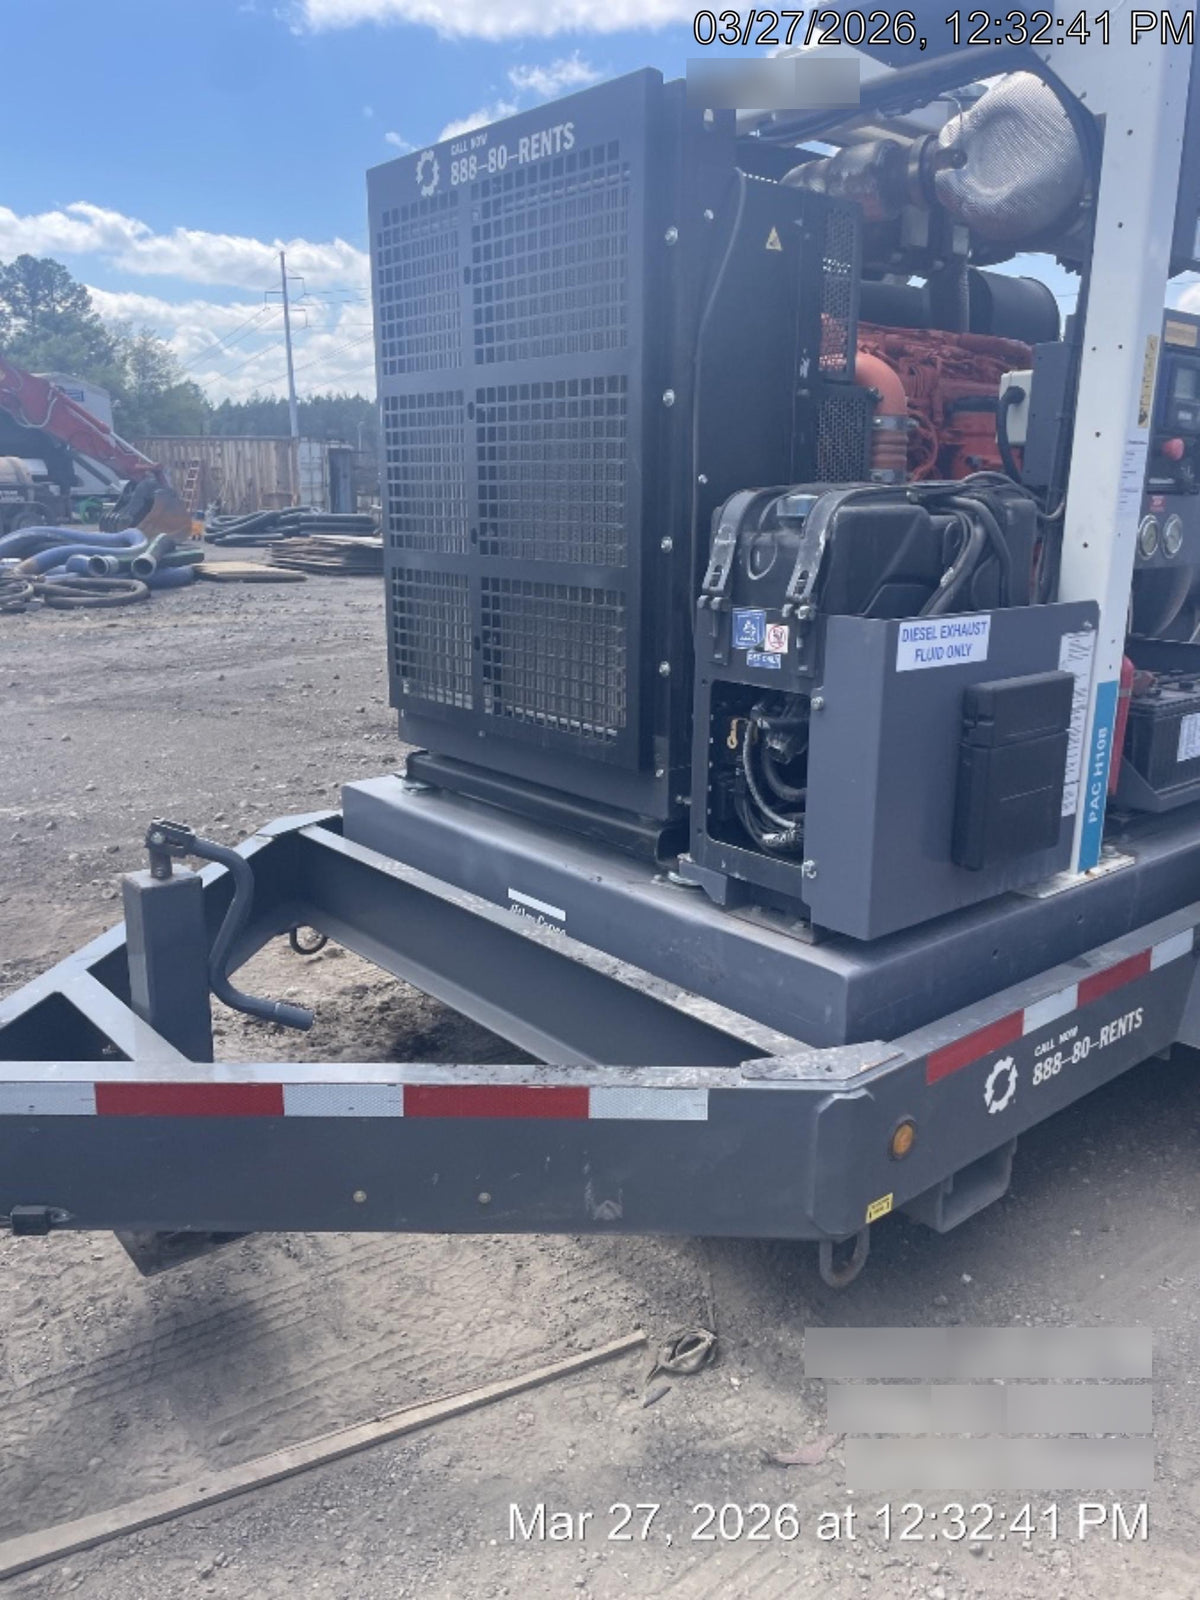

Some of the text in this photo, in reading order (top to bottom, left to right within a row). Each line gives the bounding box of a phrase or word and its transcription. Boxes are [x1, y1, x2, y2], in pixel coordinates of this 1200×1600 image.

[450, 121, 576, 186] 888-80-RENTS
[451, 133, 488, 155] CALL NOW
[901, 621, 988, 643] DIESEL EXHAUST
[914, 643, 973, 663] FLUID ONLY
[1087, 782, 1102, 824] PAC
[1032, 1007, 1144, 1086] 888-80-RENTS
[1034, 1025, 1079, 1056] CALL NOW
